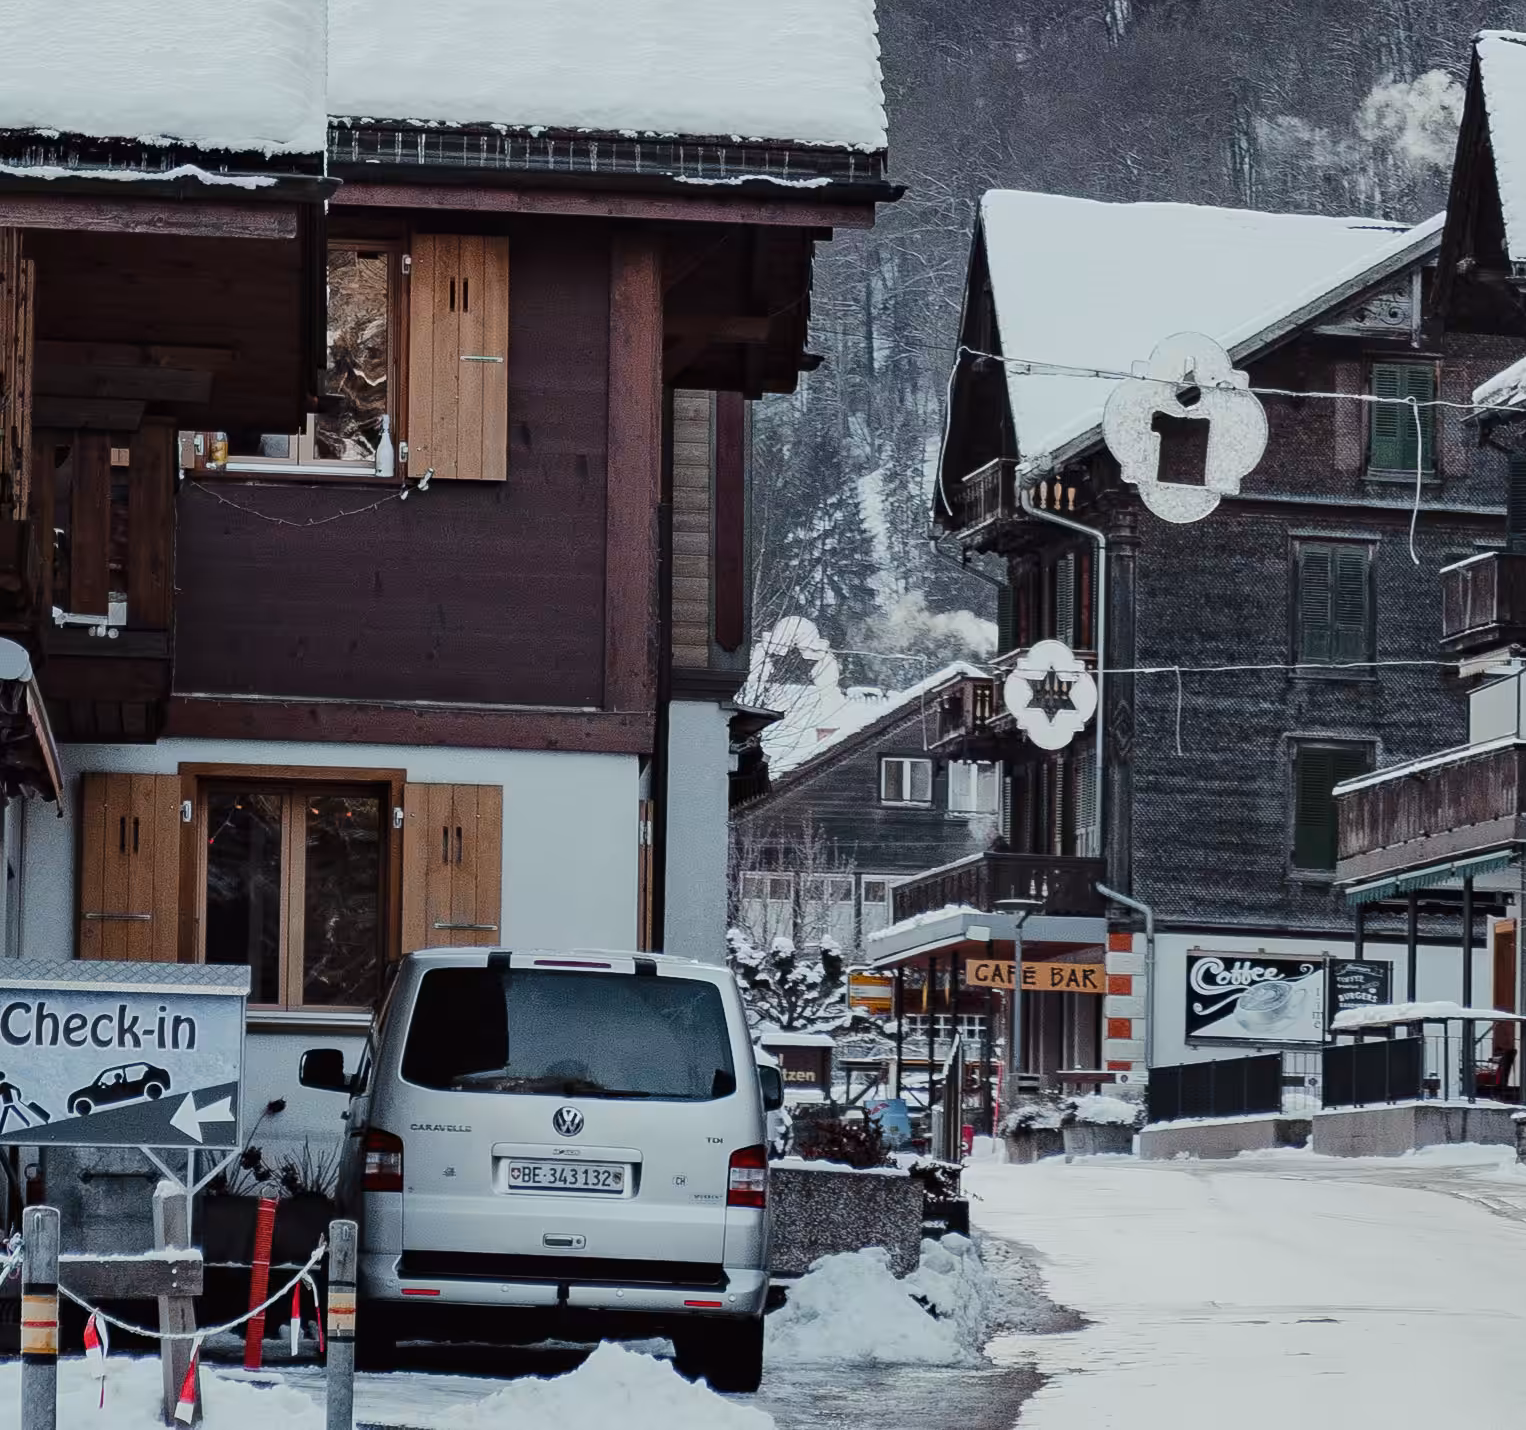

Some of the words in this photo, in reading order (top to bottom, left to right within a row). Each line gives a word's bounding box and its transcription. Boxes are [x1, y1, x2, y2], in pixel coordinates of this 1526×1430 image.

[1050, 967, 1097, 989] BAR
[1190, 957, 1285, 995] Coffee
[1, 1002, 196, 1050] Check-in
